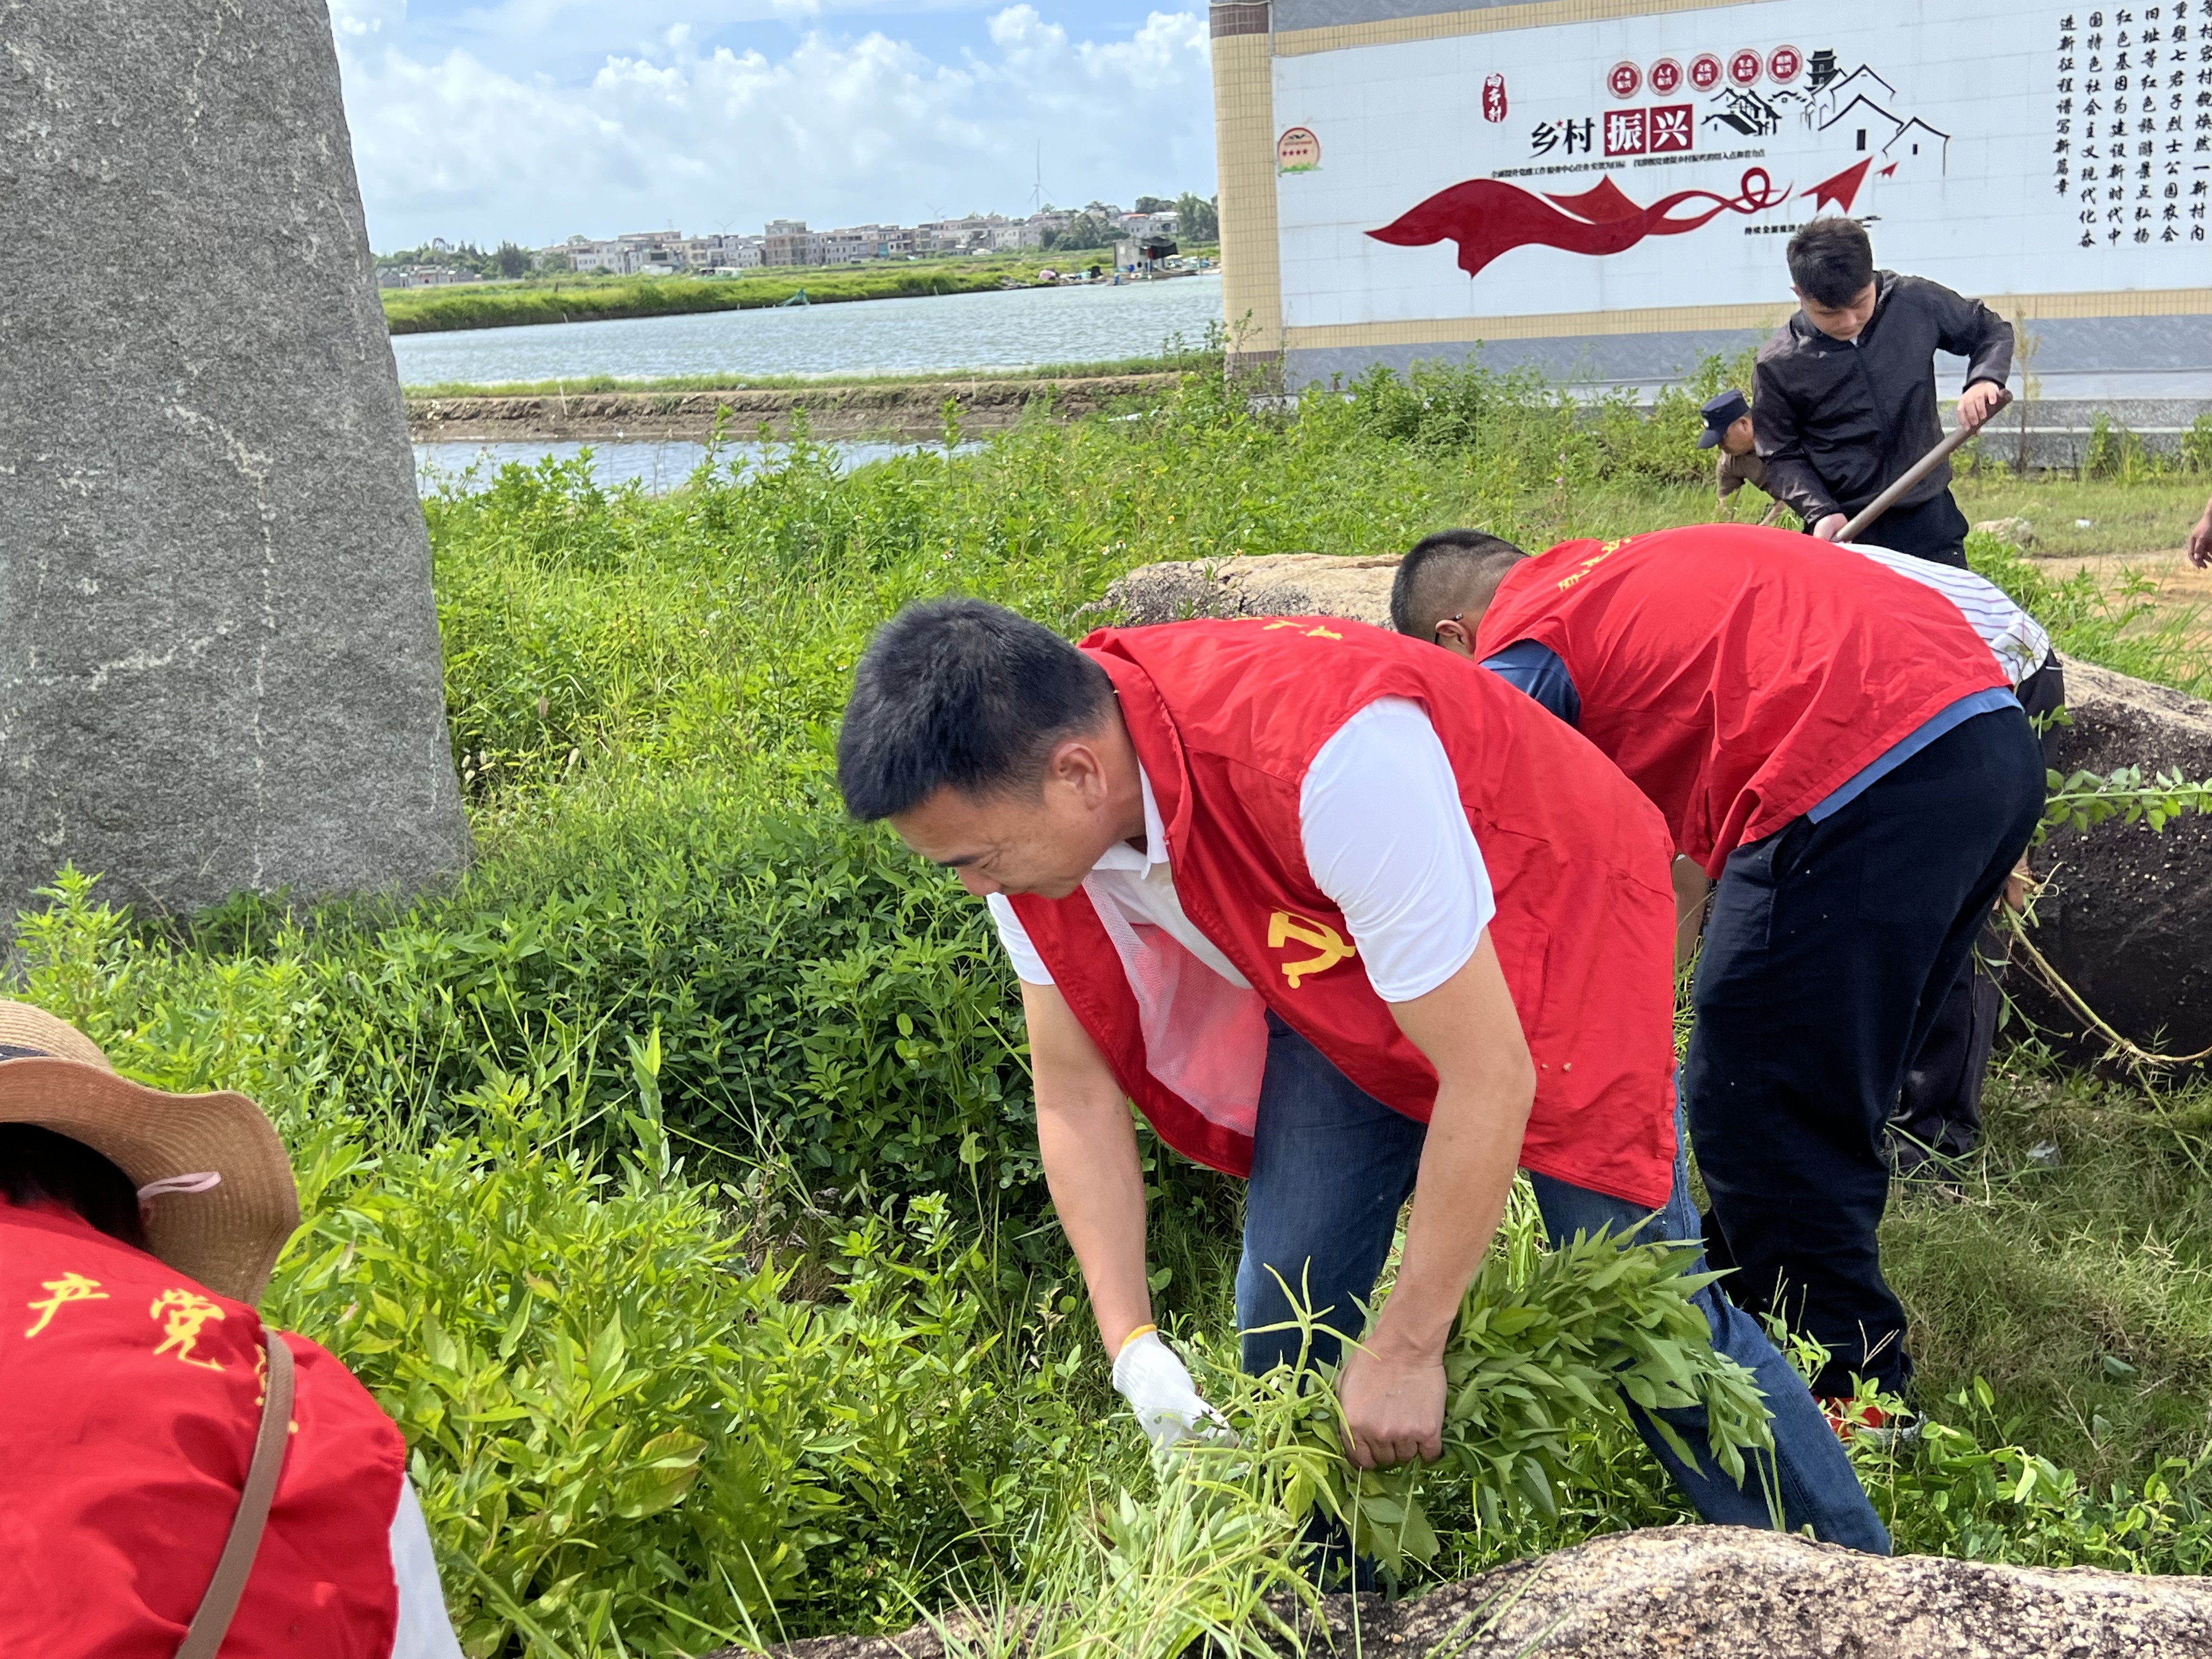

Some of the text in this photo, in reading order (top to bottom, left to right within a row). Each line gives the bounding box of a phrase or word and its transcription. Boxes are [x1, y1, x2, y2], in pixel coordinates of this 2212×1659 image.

[1529, 110, 1689, 158] 乡村振兴
[2053, 14, 2078, 198] 进新征程谱写新篇章
[2078, 11, 2103, 249] 国特色社会主义现代化奋
[2106, 9, 2133, 246] 红色基因为建设新时代中
[2133, 7, 2160, 244] 旧址等红色旅游景点弘扬
[2160, 1, 2188, 243] 重塑七君子烈士公园农会
